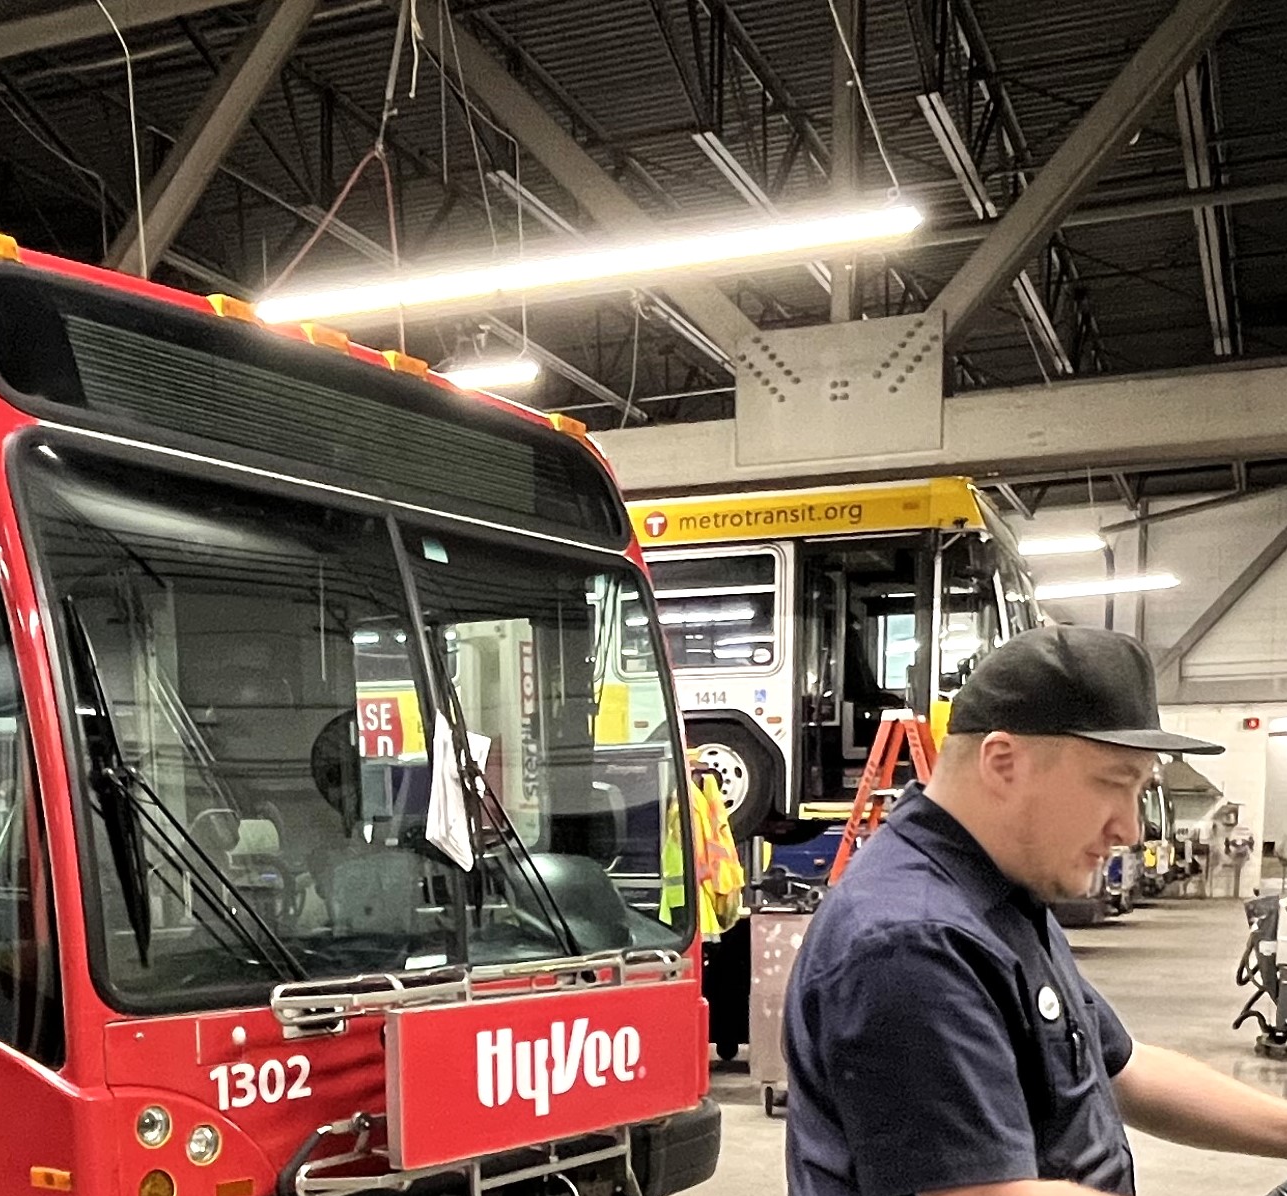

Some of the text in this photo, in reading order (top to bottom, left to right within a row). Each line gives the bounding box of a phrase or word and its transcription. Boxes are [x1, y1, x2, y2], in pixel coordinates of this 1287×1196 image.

[679, 503, 862, 530] metrotransit.org
[695, 691, 727, 705] 1414
[210, 1055, 312, 1111] 1302
[476, 1017, 642, 1116] HyVee
